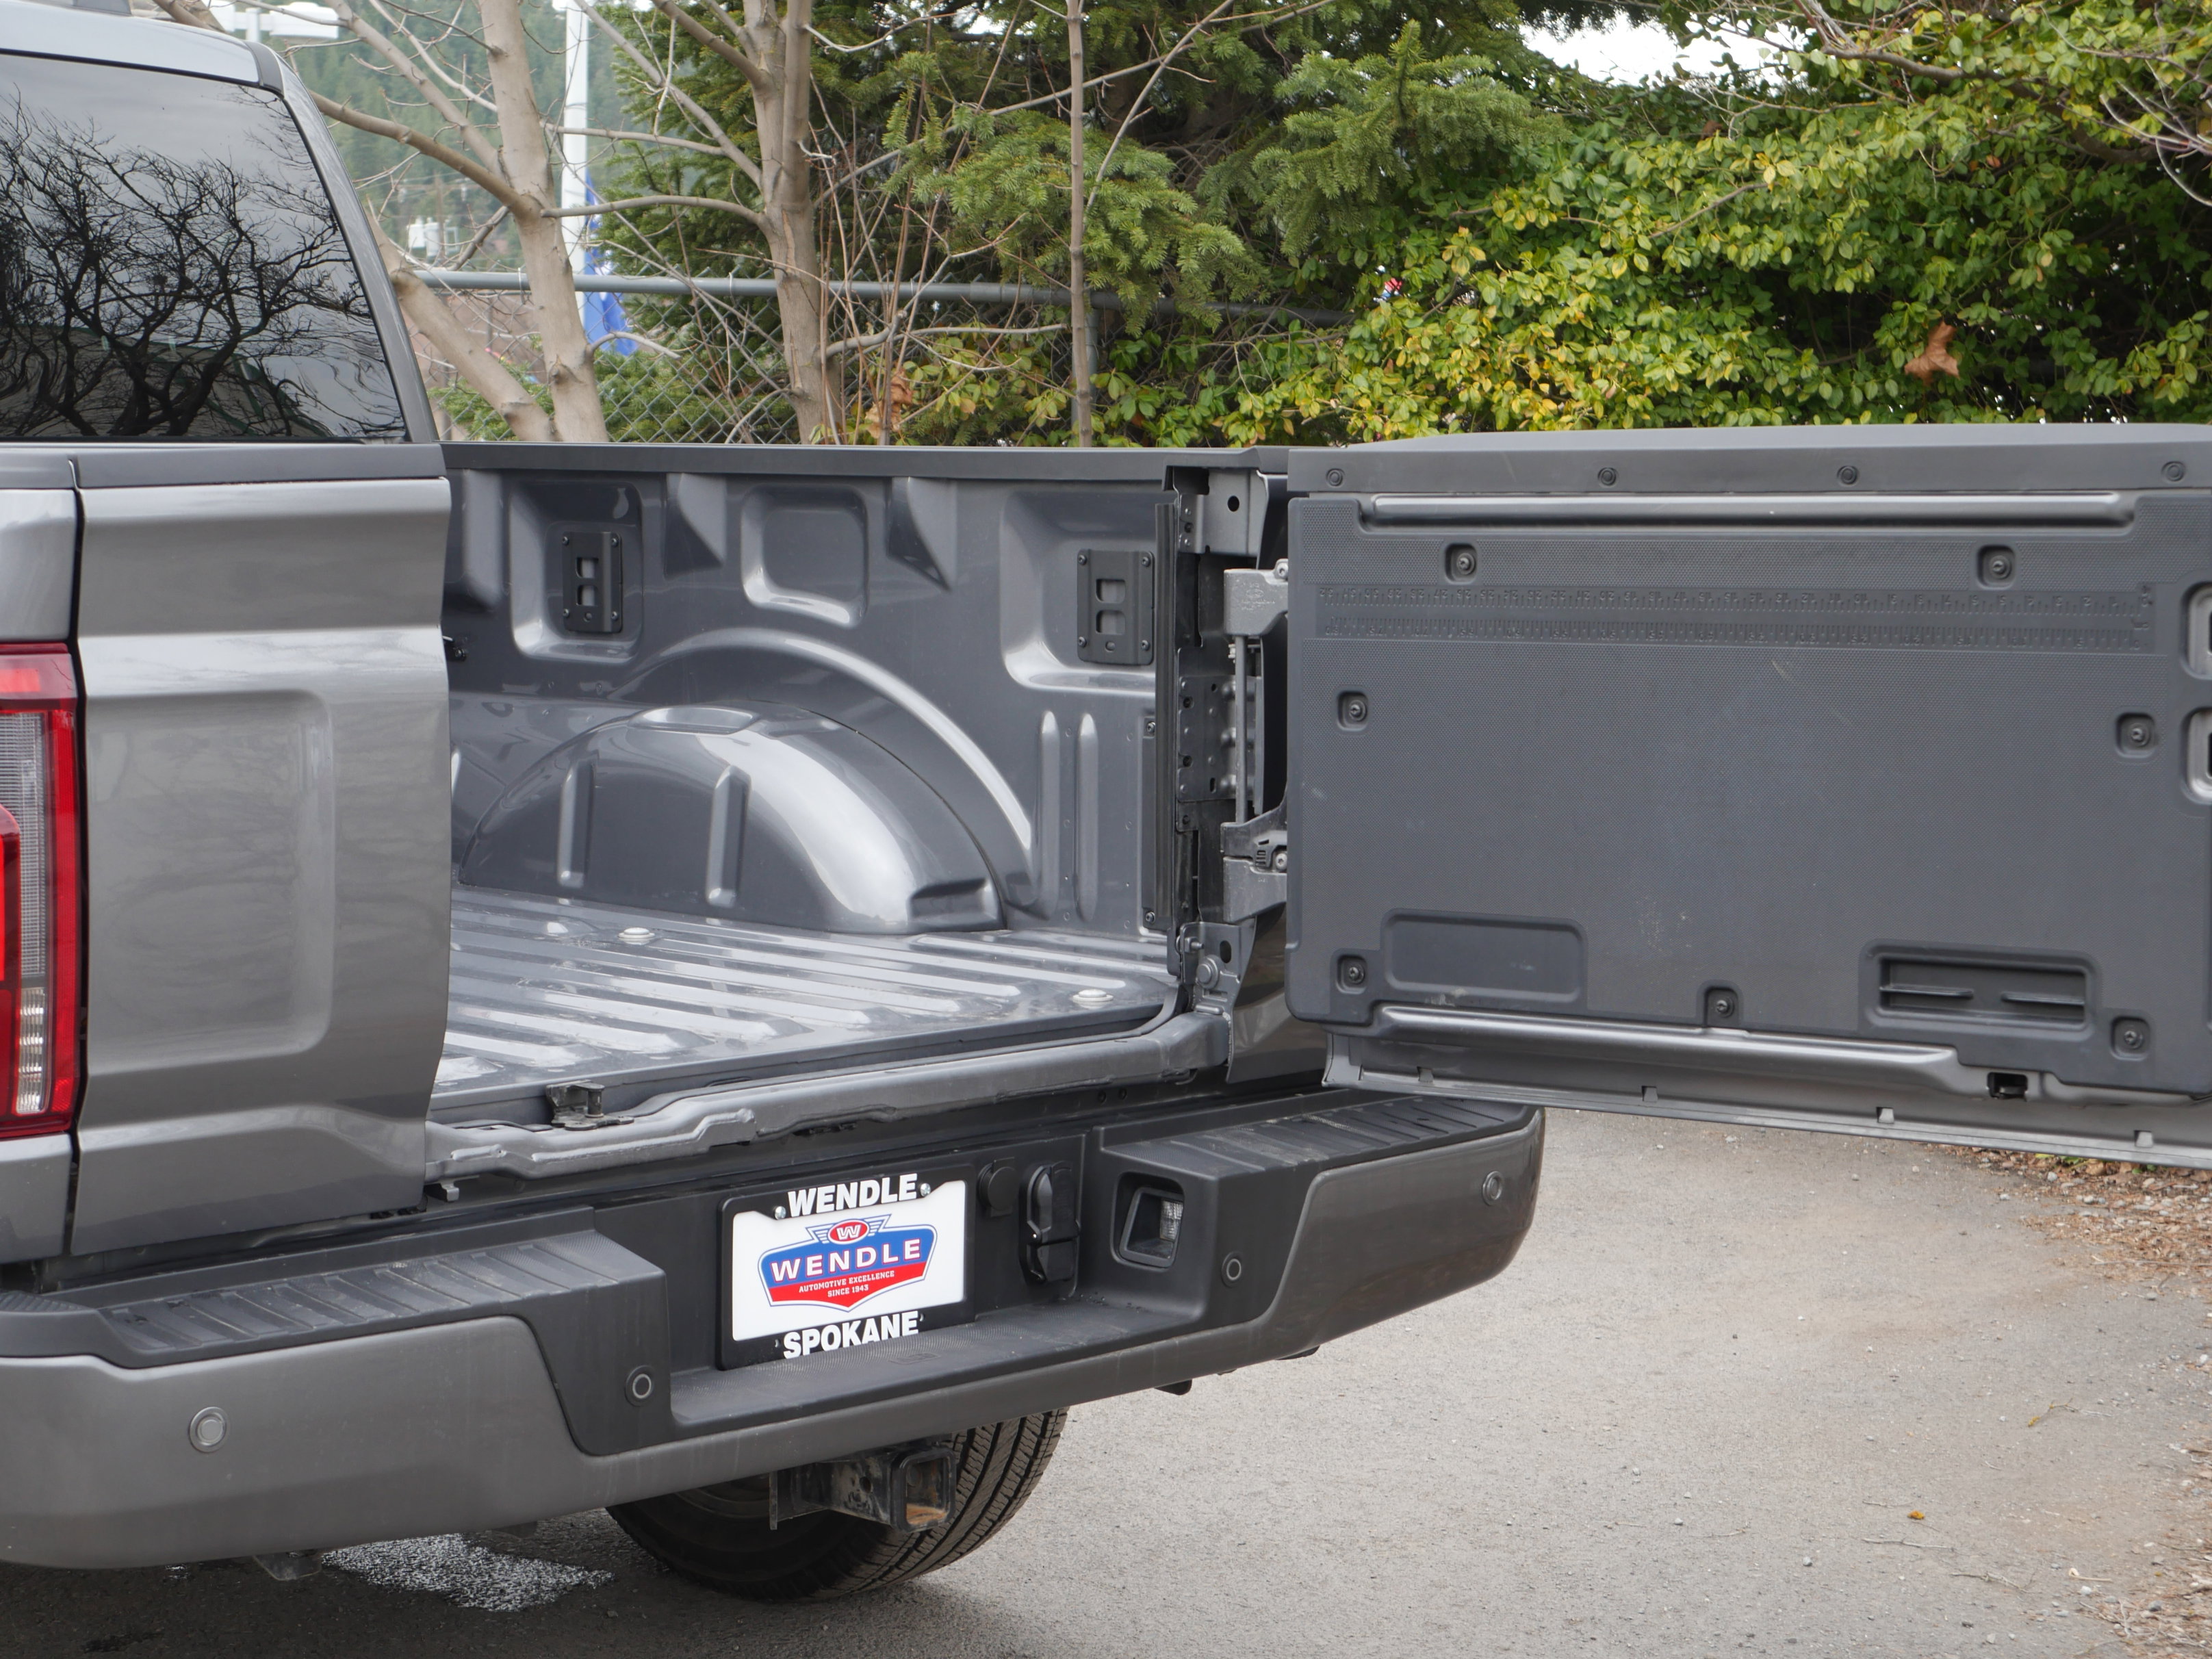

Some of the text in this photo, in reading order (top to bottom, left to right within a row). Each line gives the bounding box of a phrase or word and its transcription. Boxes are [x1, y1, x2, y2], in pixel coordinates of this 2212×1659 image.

[788, 1173, 918, 1218] WENDLE
[771, 1239, 921, 1283] WENDLE
[799, 1270, 895, 1294] AUTOMOTIVE EXCELLENCE
[827, 1287, 850, 1298] SINCE
[783, 1311, 918, 1359] SPOKANE
